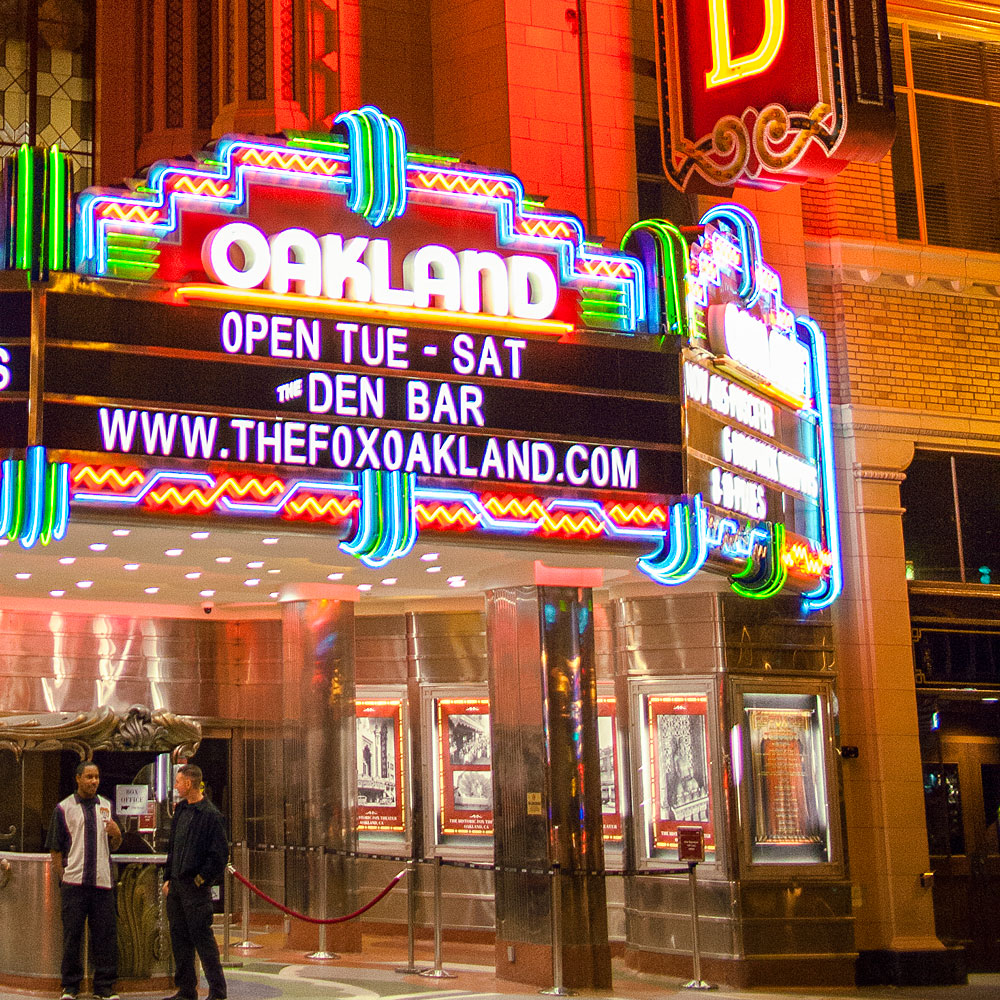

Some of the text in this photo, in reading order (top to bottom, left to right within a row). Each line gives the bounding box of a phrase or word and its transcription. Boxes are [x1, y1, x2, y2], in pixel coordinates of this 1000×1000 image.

[201, 221, 559, 320] OAKLAND
[220, 310, 321, 361] OPEN
[335, 322, 409, 369] TUE
[452, 333, 527, 379] SAT
[275, 371, 486, 427] THE DEN BAR
[98, 407, 639, 489] WWW.THEFOXOAKLAND.COM
